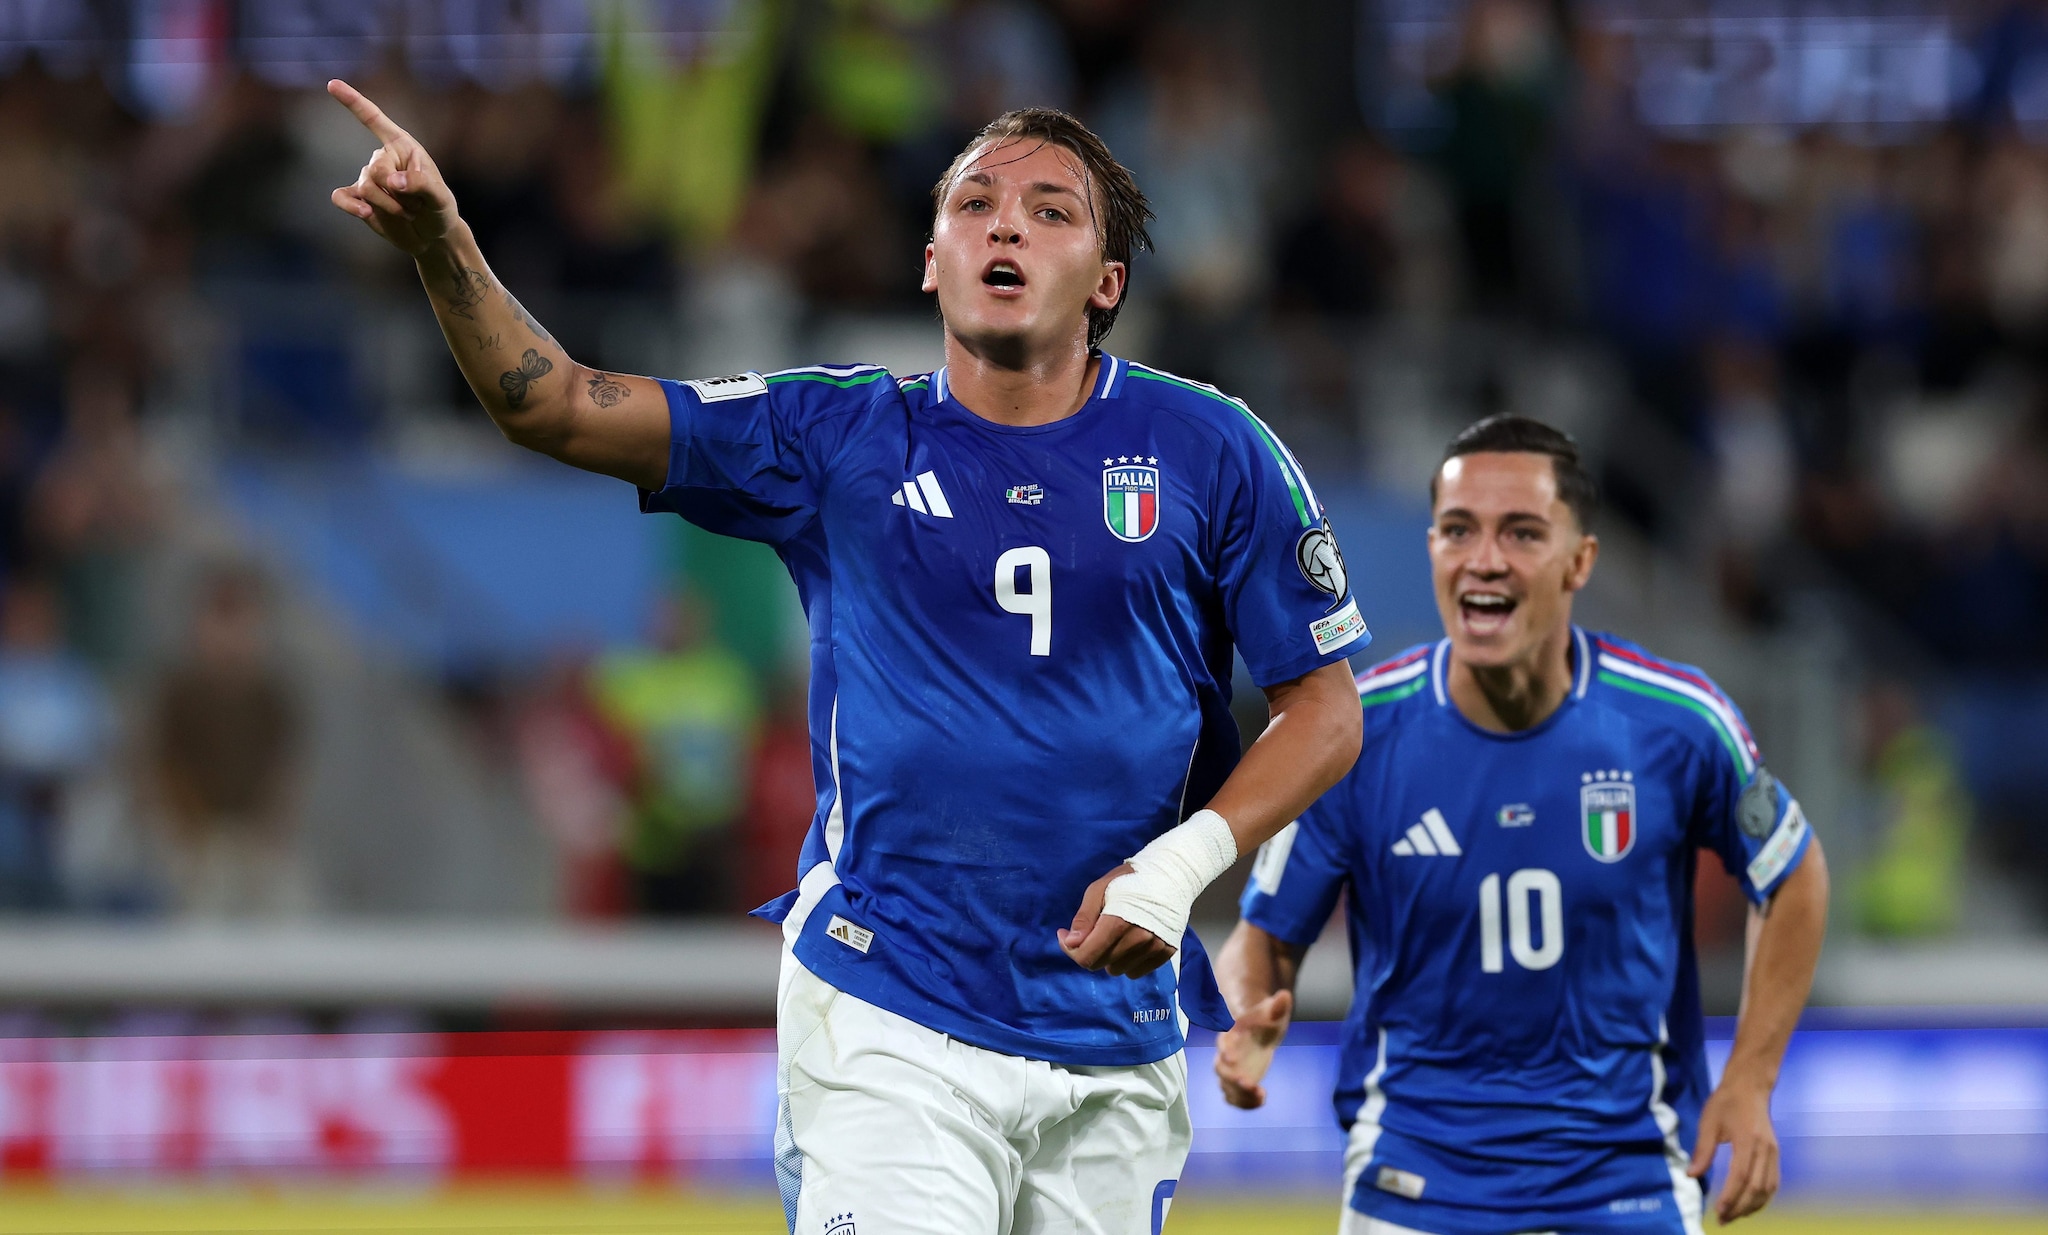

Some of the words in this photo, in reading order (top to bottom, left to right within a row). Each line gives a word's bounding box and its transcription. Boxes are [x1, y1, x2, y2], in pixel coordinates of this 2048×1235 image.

[1108, 472, 1154, 486] ITALIA
[995, 546, 1050, 656] 9
[1313, 620, 1330, 631] UEFA
[1479, 868, 1564, 973] 10
[1133, 1008, 1171, 1023] HEAT.RDY
